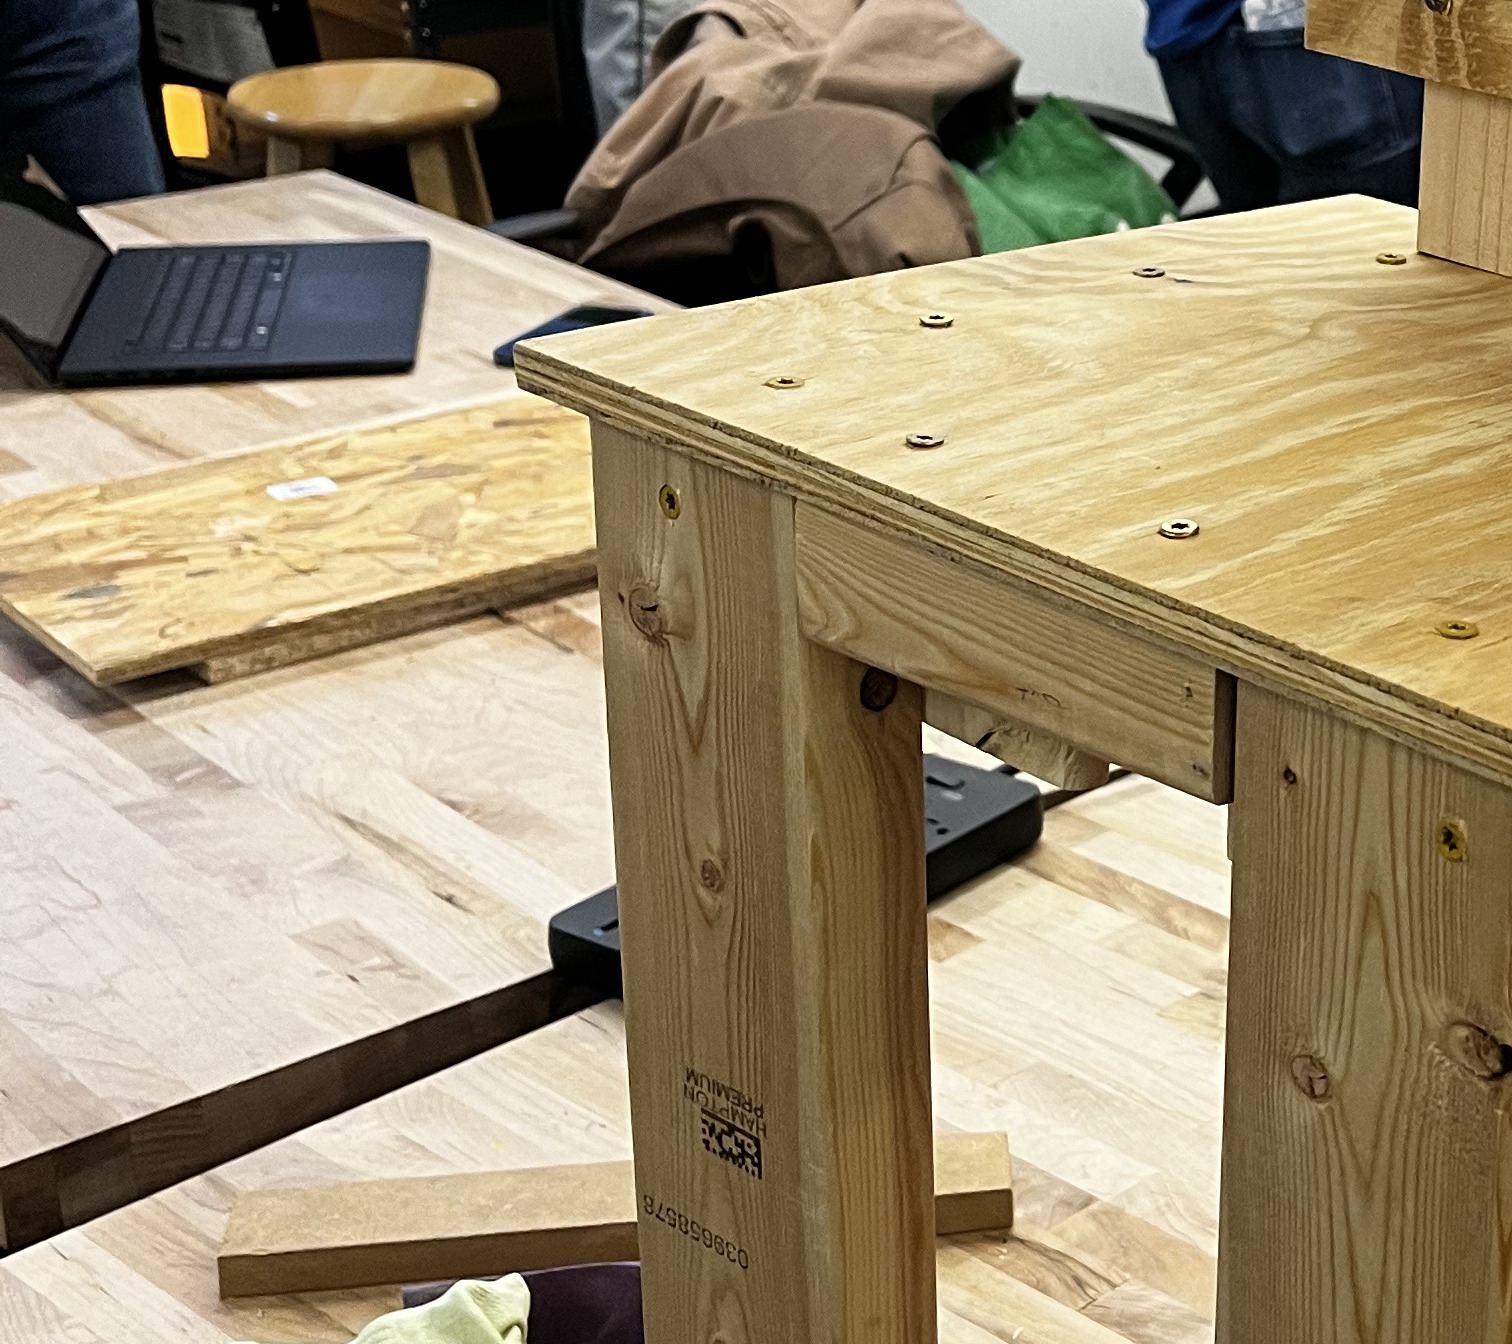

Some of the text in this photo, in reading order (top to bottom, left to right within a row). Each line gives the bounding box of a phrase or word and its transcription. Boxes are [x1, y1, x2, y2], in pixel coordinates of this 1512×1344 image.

[683, 1083, 767, 1137] HAMPTON
[686, 1067, 763, 1119] PREMIUM
[643, 1194, 749, 1270] 039658578
